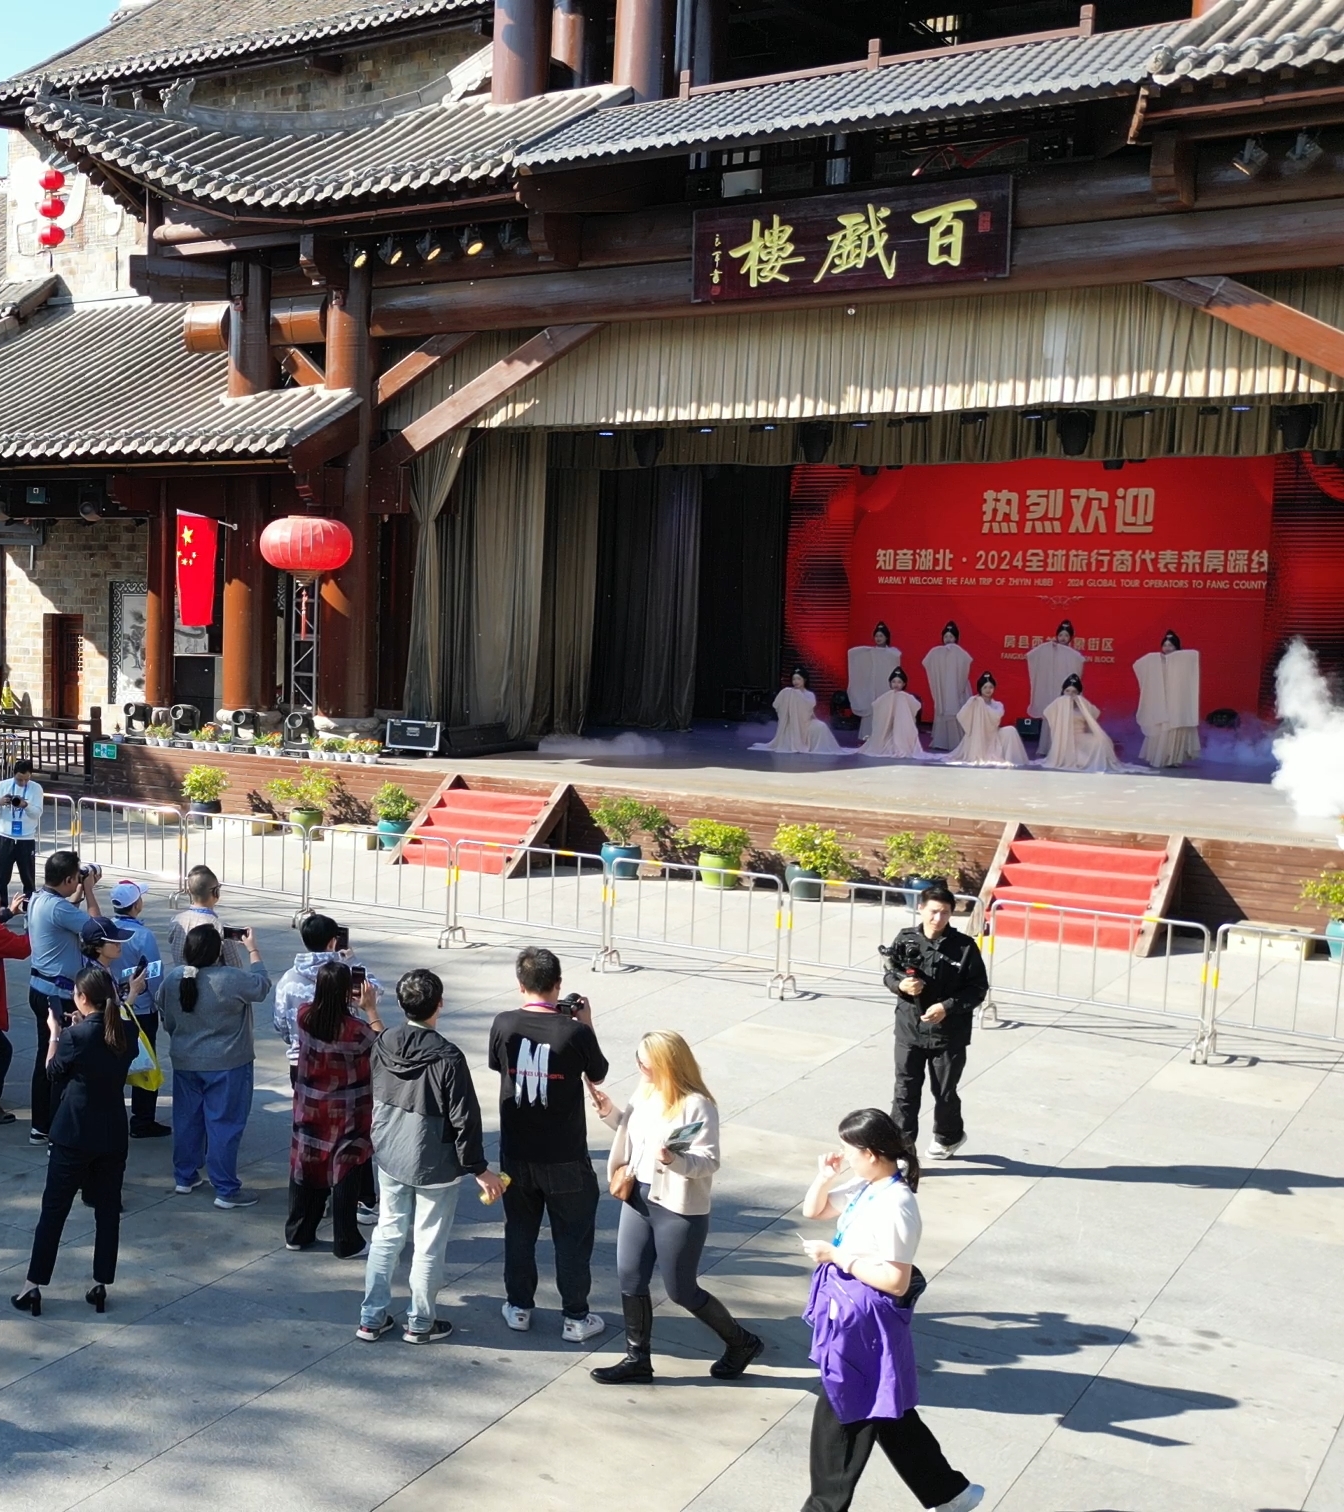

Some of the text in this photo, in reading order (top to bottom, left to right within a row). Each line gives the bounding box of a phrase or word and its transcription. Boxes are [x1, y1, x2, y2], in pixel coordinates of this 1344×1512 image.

[981, 487, 1155, 534] 热烈欢迎
[877, 576, 907, 585] WARMLY
[909, 576, 943, 586] WELCOME
[946, 577, 958, 586] THE
[960, 577, 976, 586] FAM
[979, 577, 993, 586] TRIP
[996, 578, 1006, 586] OF
[1067, 578, 1085, 588] 2024
[1086, 579, 1117, 588] GLOBAL
[1120, 579, 1140, 588] TOUR
[1143, 579, 1189, 589] OPERATORS
[1192, 580, 1203, 589] TO
[1206, 580, 1230, 590] FANG
[1233, 580, 1268, 590] COUNTY
